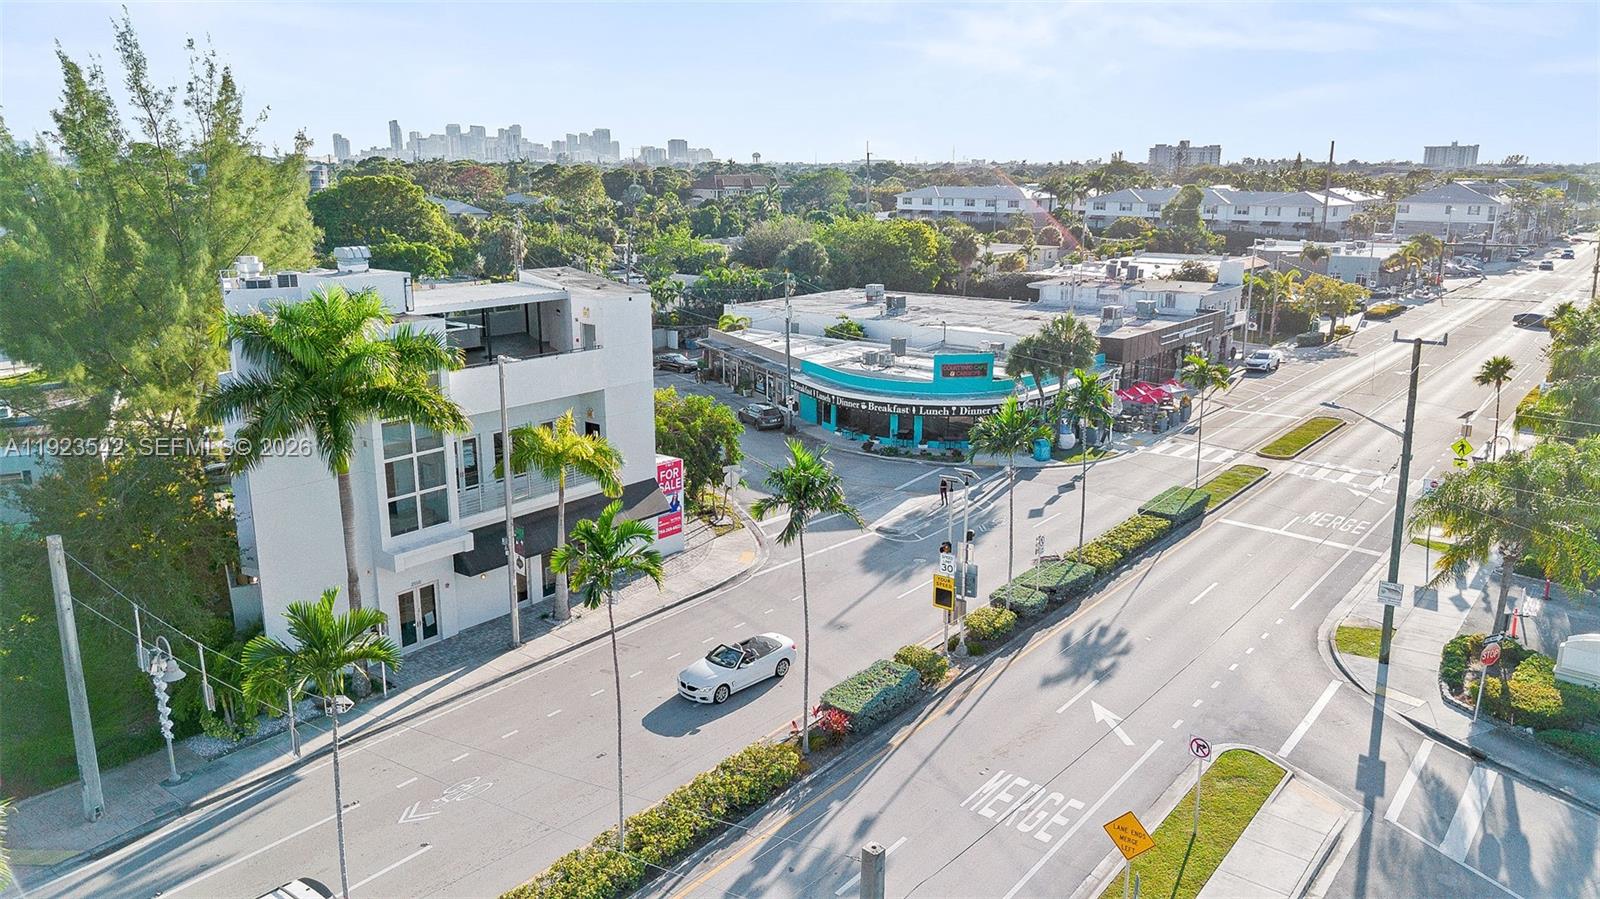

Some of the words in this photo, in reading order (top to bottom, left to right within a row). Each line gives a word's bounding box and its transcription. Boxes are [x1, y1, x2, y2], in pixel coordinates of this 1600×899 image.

[836, 396, 860, 409] Dinner
[868, 402, 909, 414] Breakfast
[919, 406, 949, 416] Lunch
[960, 406, 991, 416] Dinner
[660, 467, 679, 481] FOR
[659, 478, 682, 491] SALE
[1302, 511, 1371, 534] MERGE
[941, 564, 954, 573] 30
[1482, 648, 1499, 660] STOP
[959, 770, 1085, 843] MERGE
[1113, 823, 1128, 833] LANE
[1130, 830, 1146, 840] ENDS
[1119, 835, 1138, 845] MERGE
[1121, 845, 1135, 854] LEFT
